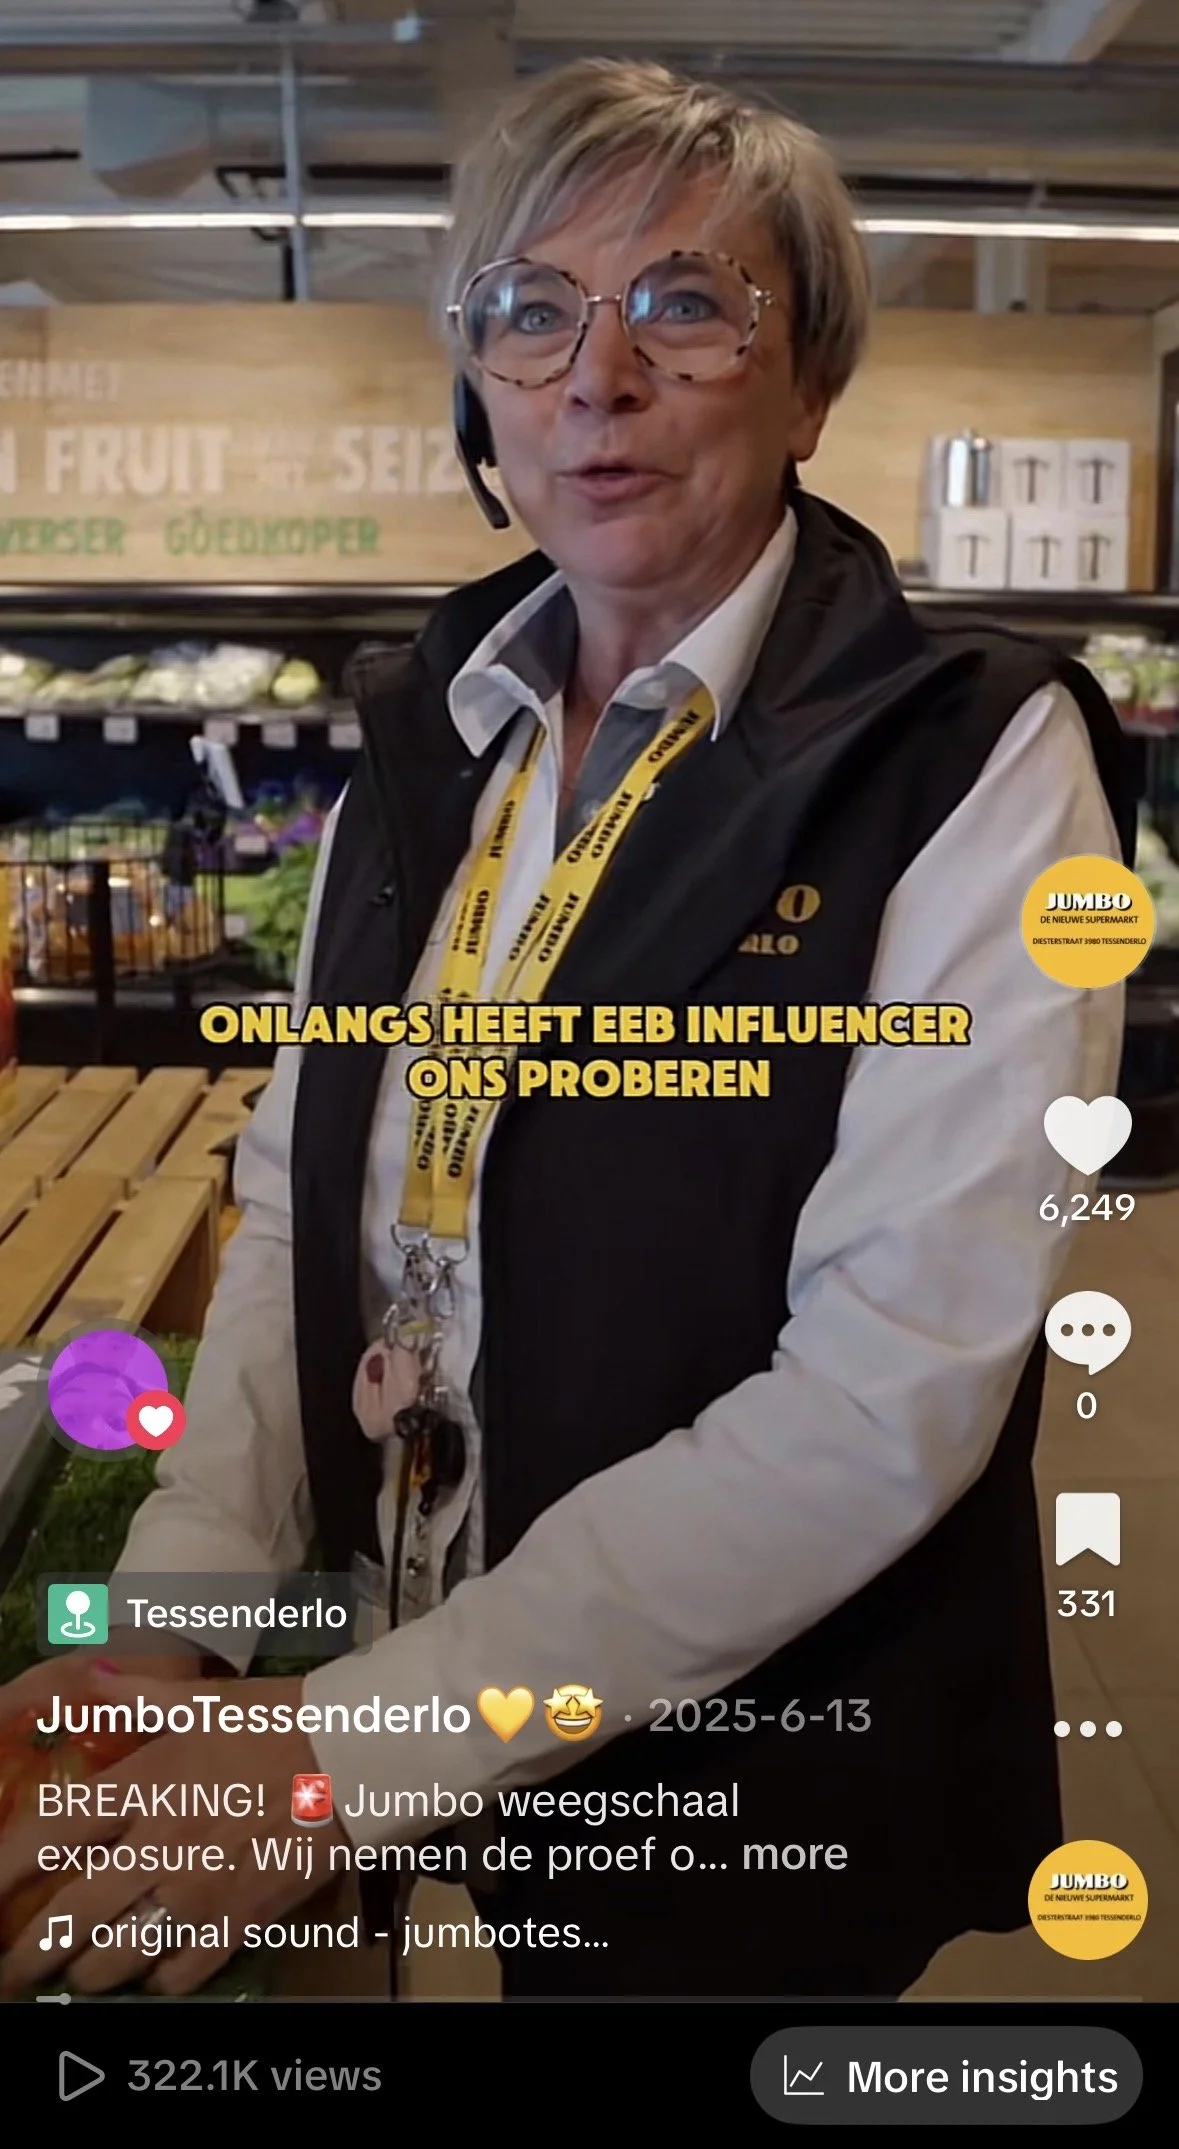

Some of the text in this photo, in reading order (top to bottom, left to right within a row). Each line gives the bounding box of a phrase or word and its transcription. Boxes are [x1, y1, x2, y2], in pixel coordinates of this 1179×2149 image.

[46, 427, 231, 495] FRUIT
[648, 710, 700, 762] JUMBO
[591, 790, 633, 858] JUMBO
[508, 893, 551, 961] JUMBO
[538, 892, 580, 962] JUMBO
[447, 1106, 479, 1178] JUMBO
